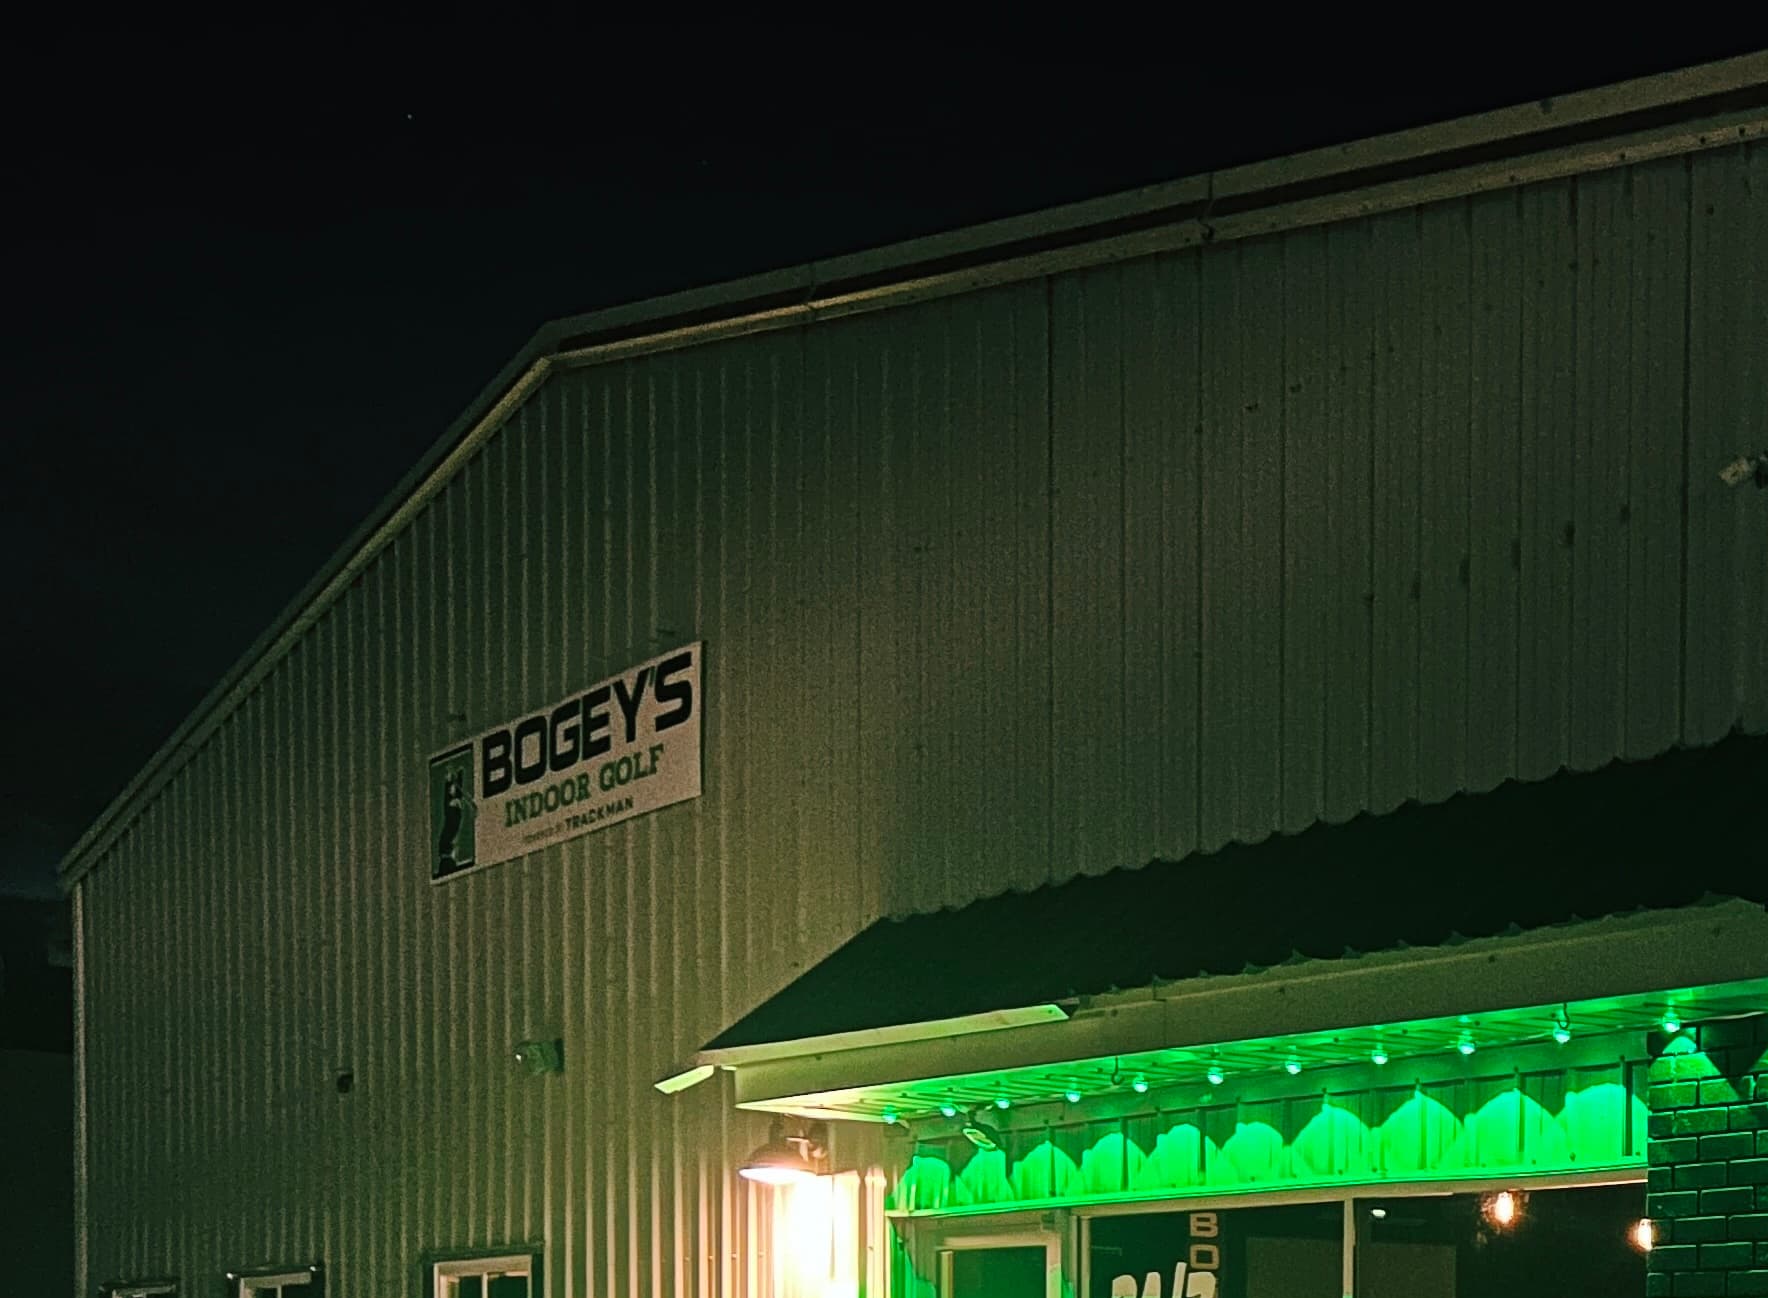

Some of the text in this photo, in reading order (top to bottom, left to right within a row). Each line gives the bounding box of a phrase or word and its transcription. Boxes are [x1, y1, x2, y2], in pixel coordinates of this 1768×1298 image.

[482, 652, 692, 798] BOGEY'S
[504, 744, 663, 828] INDOOR GOLF
[565, 795, 632, 831] TRACKMAN
